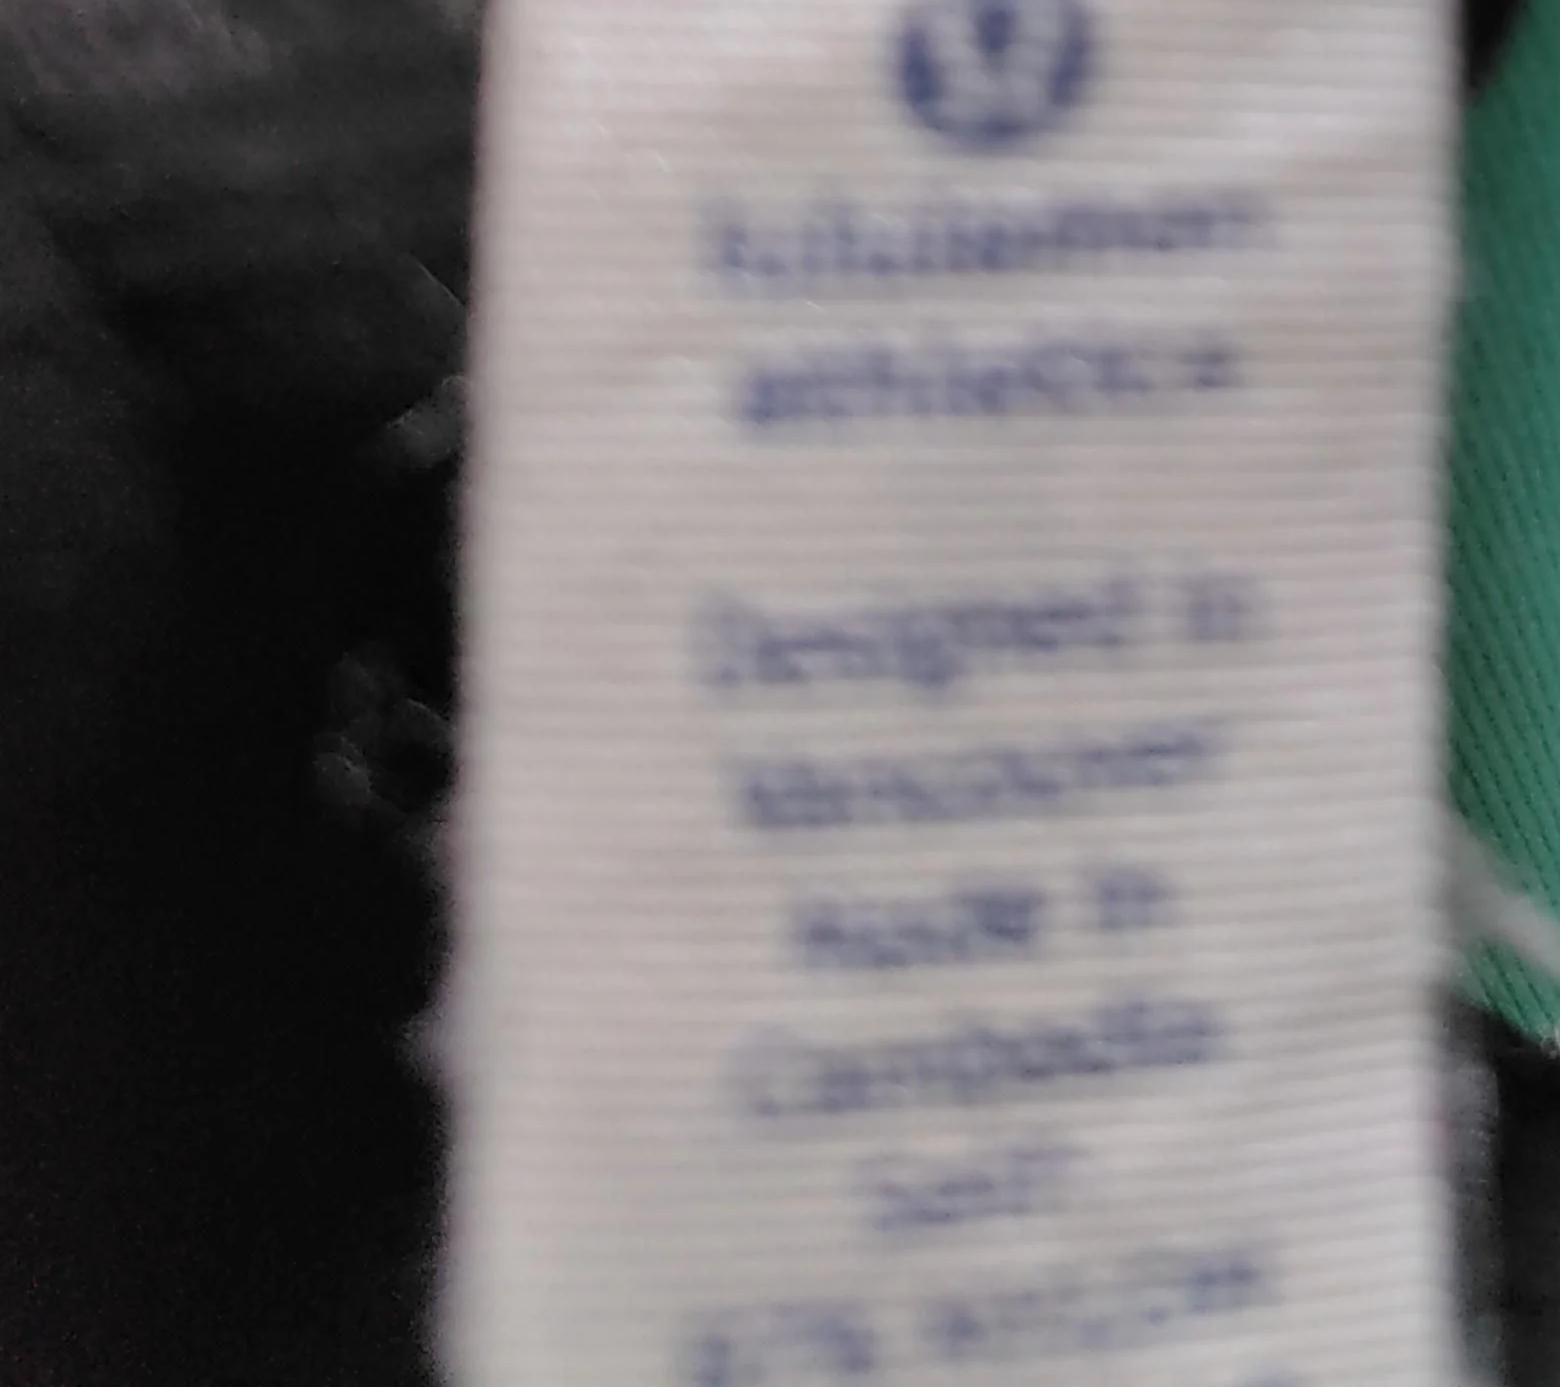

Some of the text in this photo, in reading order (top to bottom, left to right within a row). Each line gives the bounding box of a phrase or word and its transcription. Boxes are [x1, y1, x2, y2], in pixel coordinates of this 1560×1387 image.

[695, 569, 1262, 697] Designed in
[723, 727, 1225, 829] Vancouver
[798, 886, 1042, 969] Made
[733, 999, 1225, 1120] Cambodia
